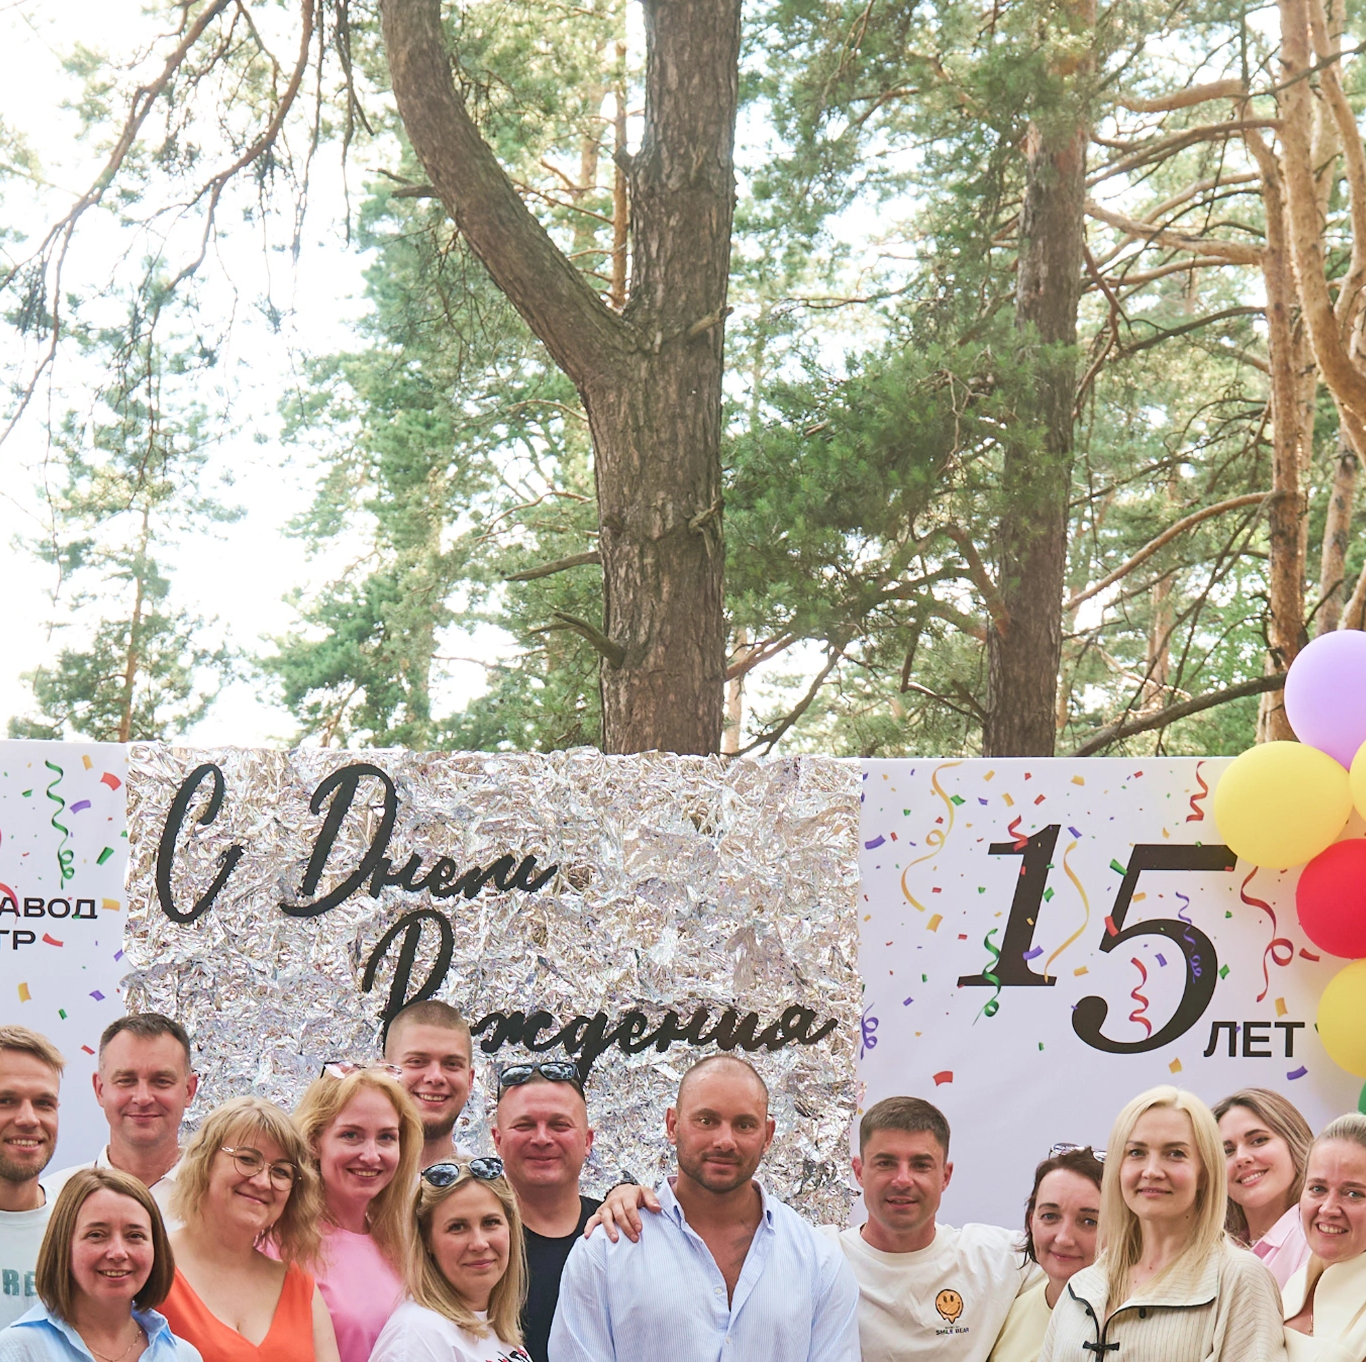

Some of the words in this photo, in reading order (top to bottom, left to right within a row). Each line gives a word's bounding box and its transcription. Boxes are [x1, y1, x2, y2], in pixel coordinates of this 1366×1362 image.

[281, 763, 559, 917] Днем
[362, 909, 840, 1085] Рждения
[957, 823, 1237, 1053] 15
[1203, 1021, 1305, 1057] ЛЕТ
